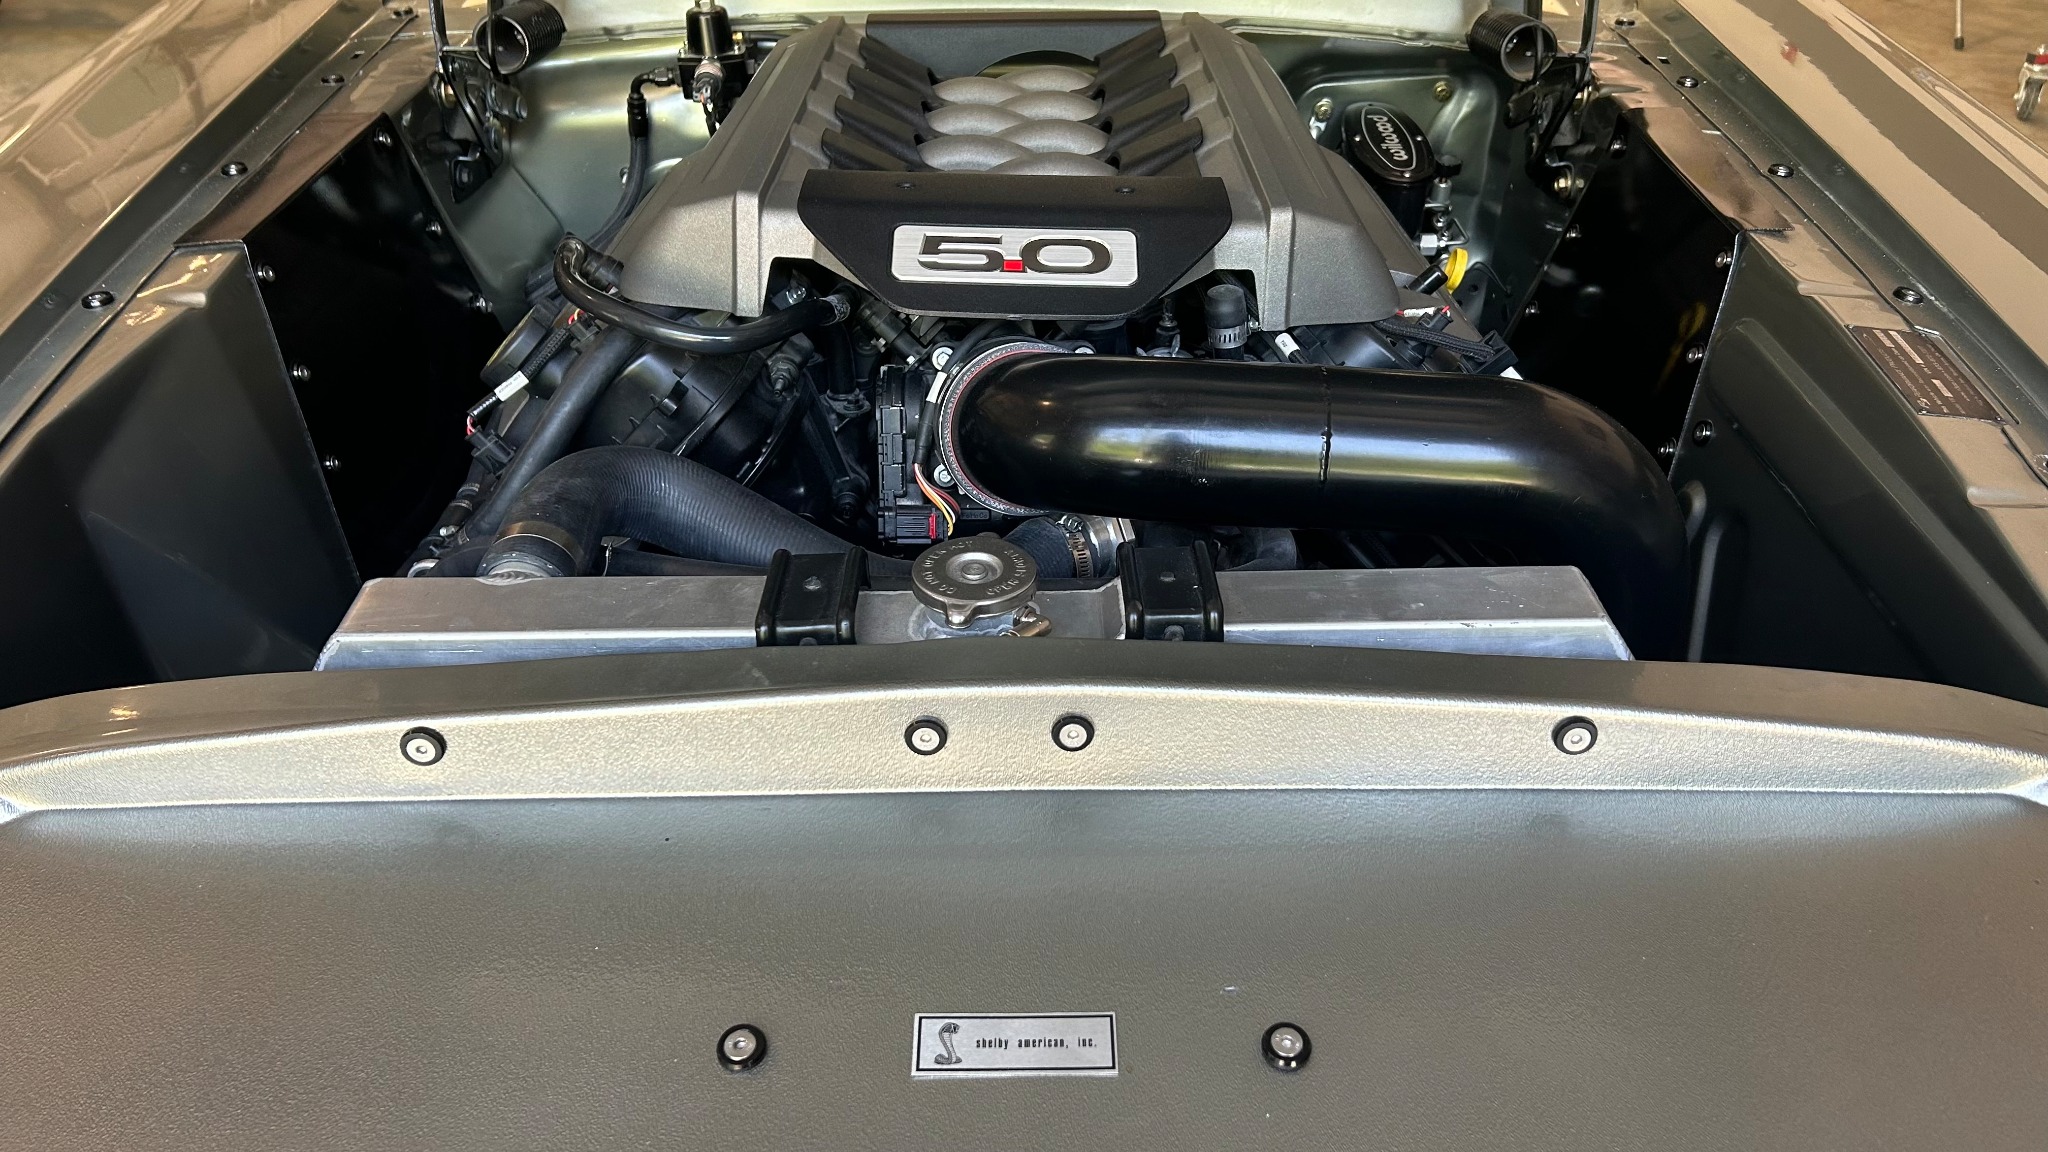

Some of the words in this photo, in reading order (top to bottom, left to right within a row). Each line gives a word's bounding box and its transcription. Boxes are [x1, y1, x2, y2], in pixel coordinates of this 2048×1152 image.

[1366, 114, 1409, 161] wilwood
[917, 232, 1113, 274] 5.0
[976, 1037, 1009, 1050] shelby
[1017, 1036, 1069, 1049] american,
[1077, 1036, 1098, 1048] inc.
